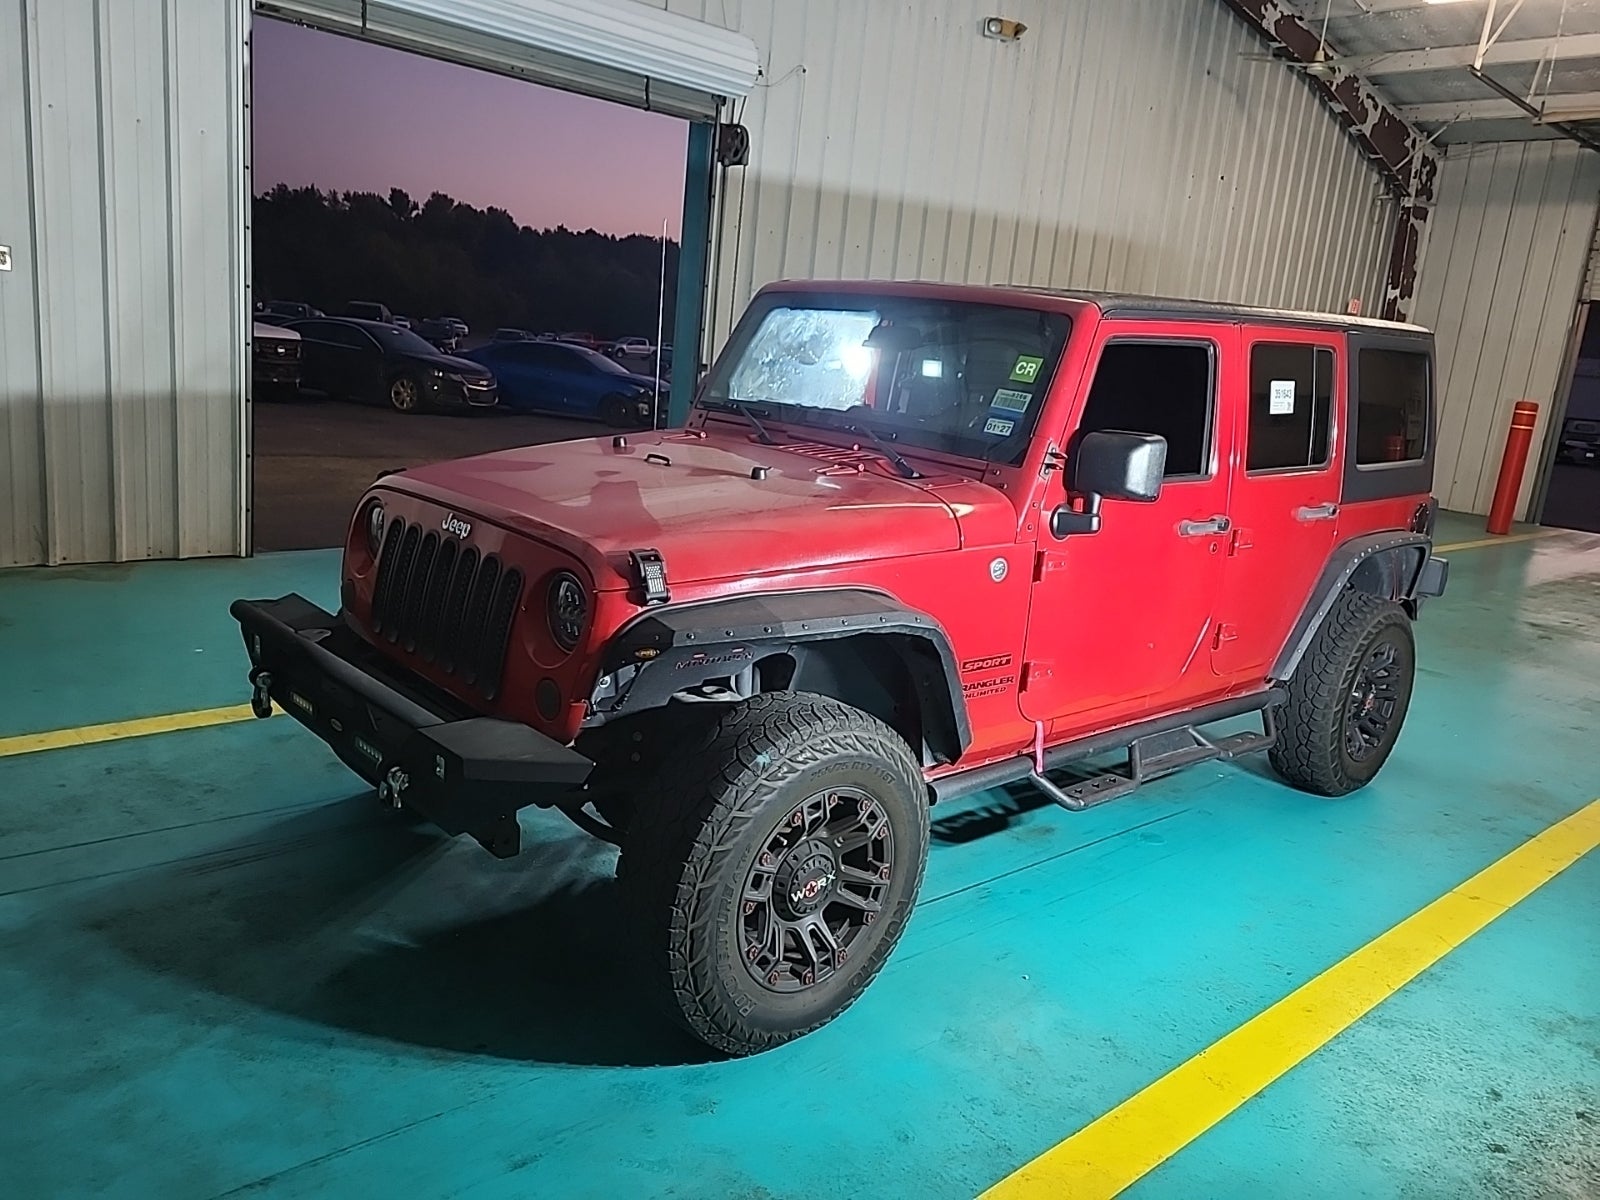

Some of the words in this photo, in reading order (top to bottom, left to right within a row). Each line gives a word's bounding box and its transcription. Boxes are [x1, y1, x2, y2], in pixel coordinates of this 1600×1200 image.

[1015, 361, 1036, 376] CR
[442, 512, 471, 540] Jeep
[964, 656, 1010, 670] SPORT
[962, 676, 1014, 691] RANGLER
[964, 686, 1007, 699] NLIMITED
[790, 869, 837, 903] WORX
[847, 899, 909, 990] KUMHO
